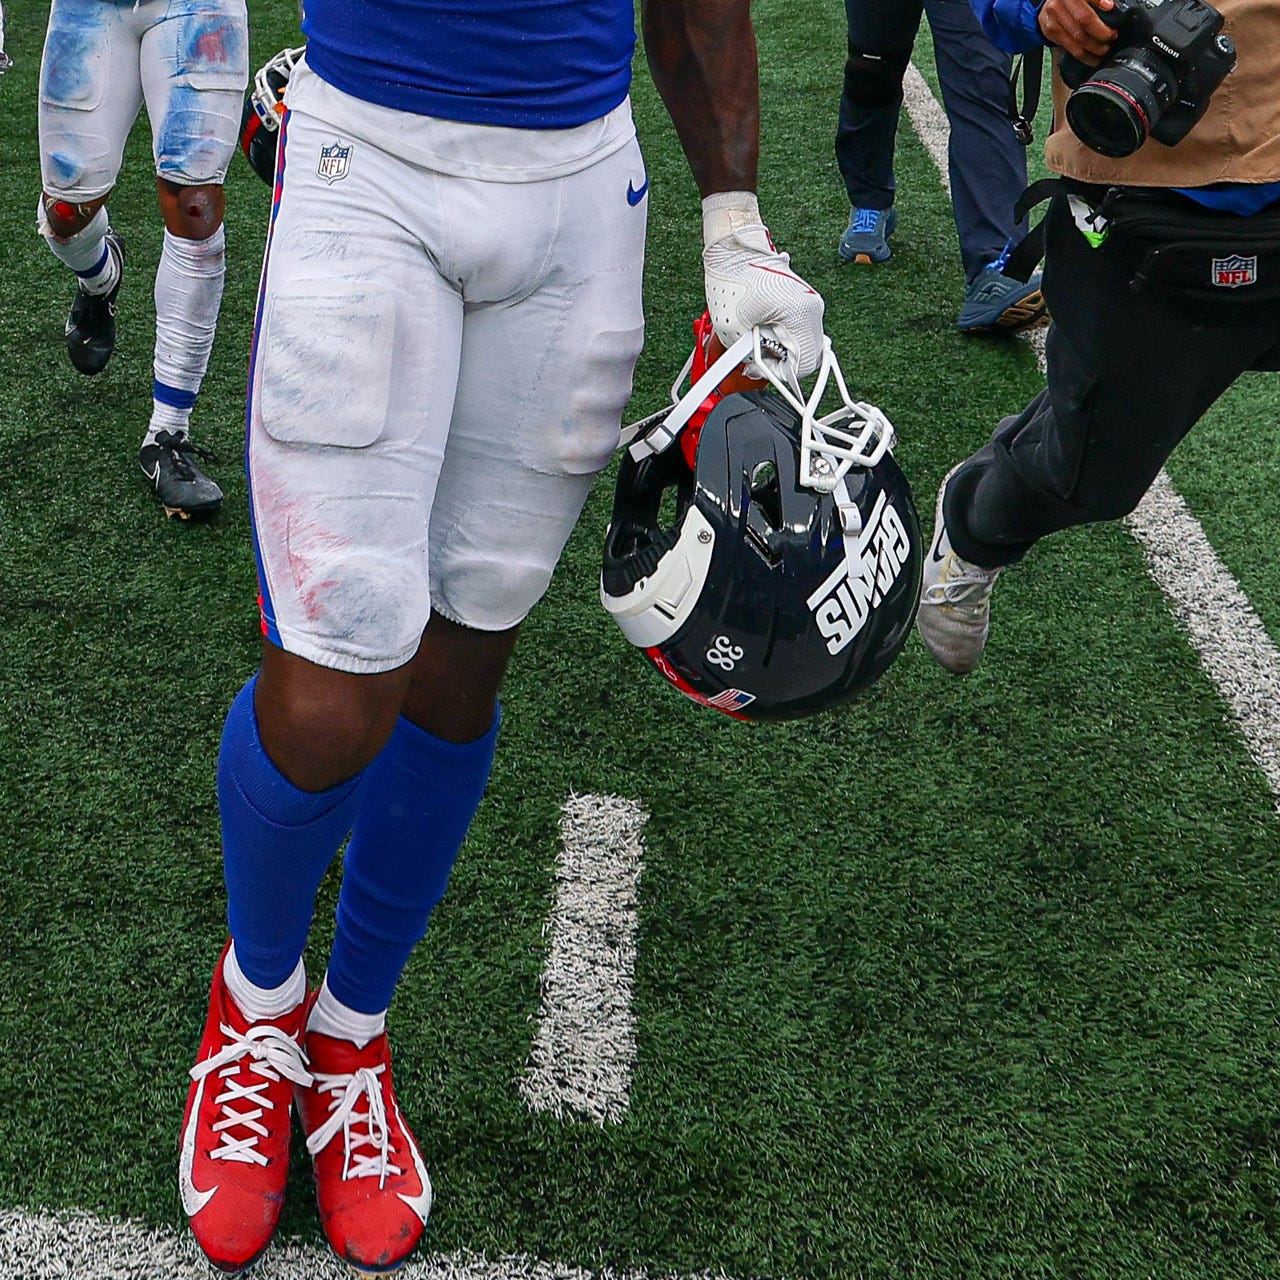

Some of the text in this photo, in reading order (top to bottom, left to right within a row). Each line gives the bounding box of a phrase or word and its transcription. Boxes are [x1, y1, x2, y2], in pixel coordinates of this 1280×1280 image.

[1152, 36, 1180, 59] Canon
[321, 158, 346, 175] NFL
[1217, 270, 1253, 287] NFL
[812, 502, 910, 656] GIANTS
